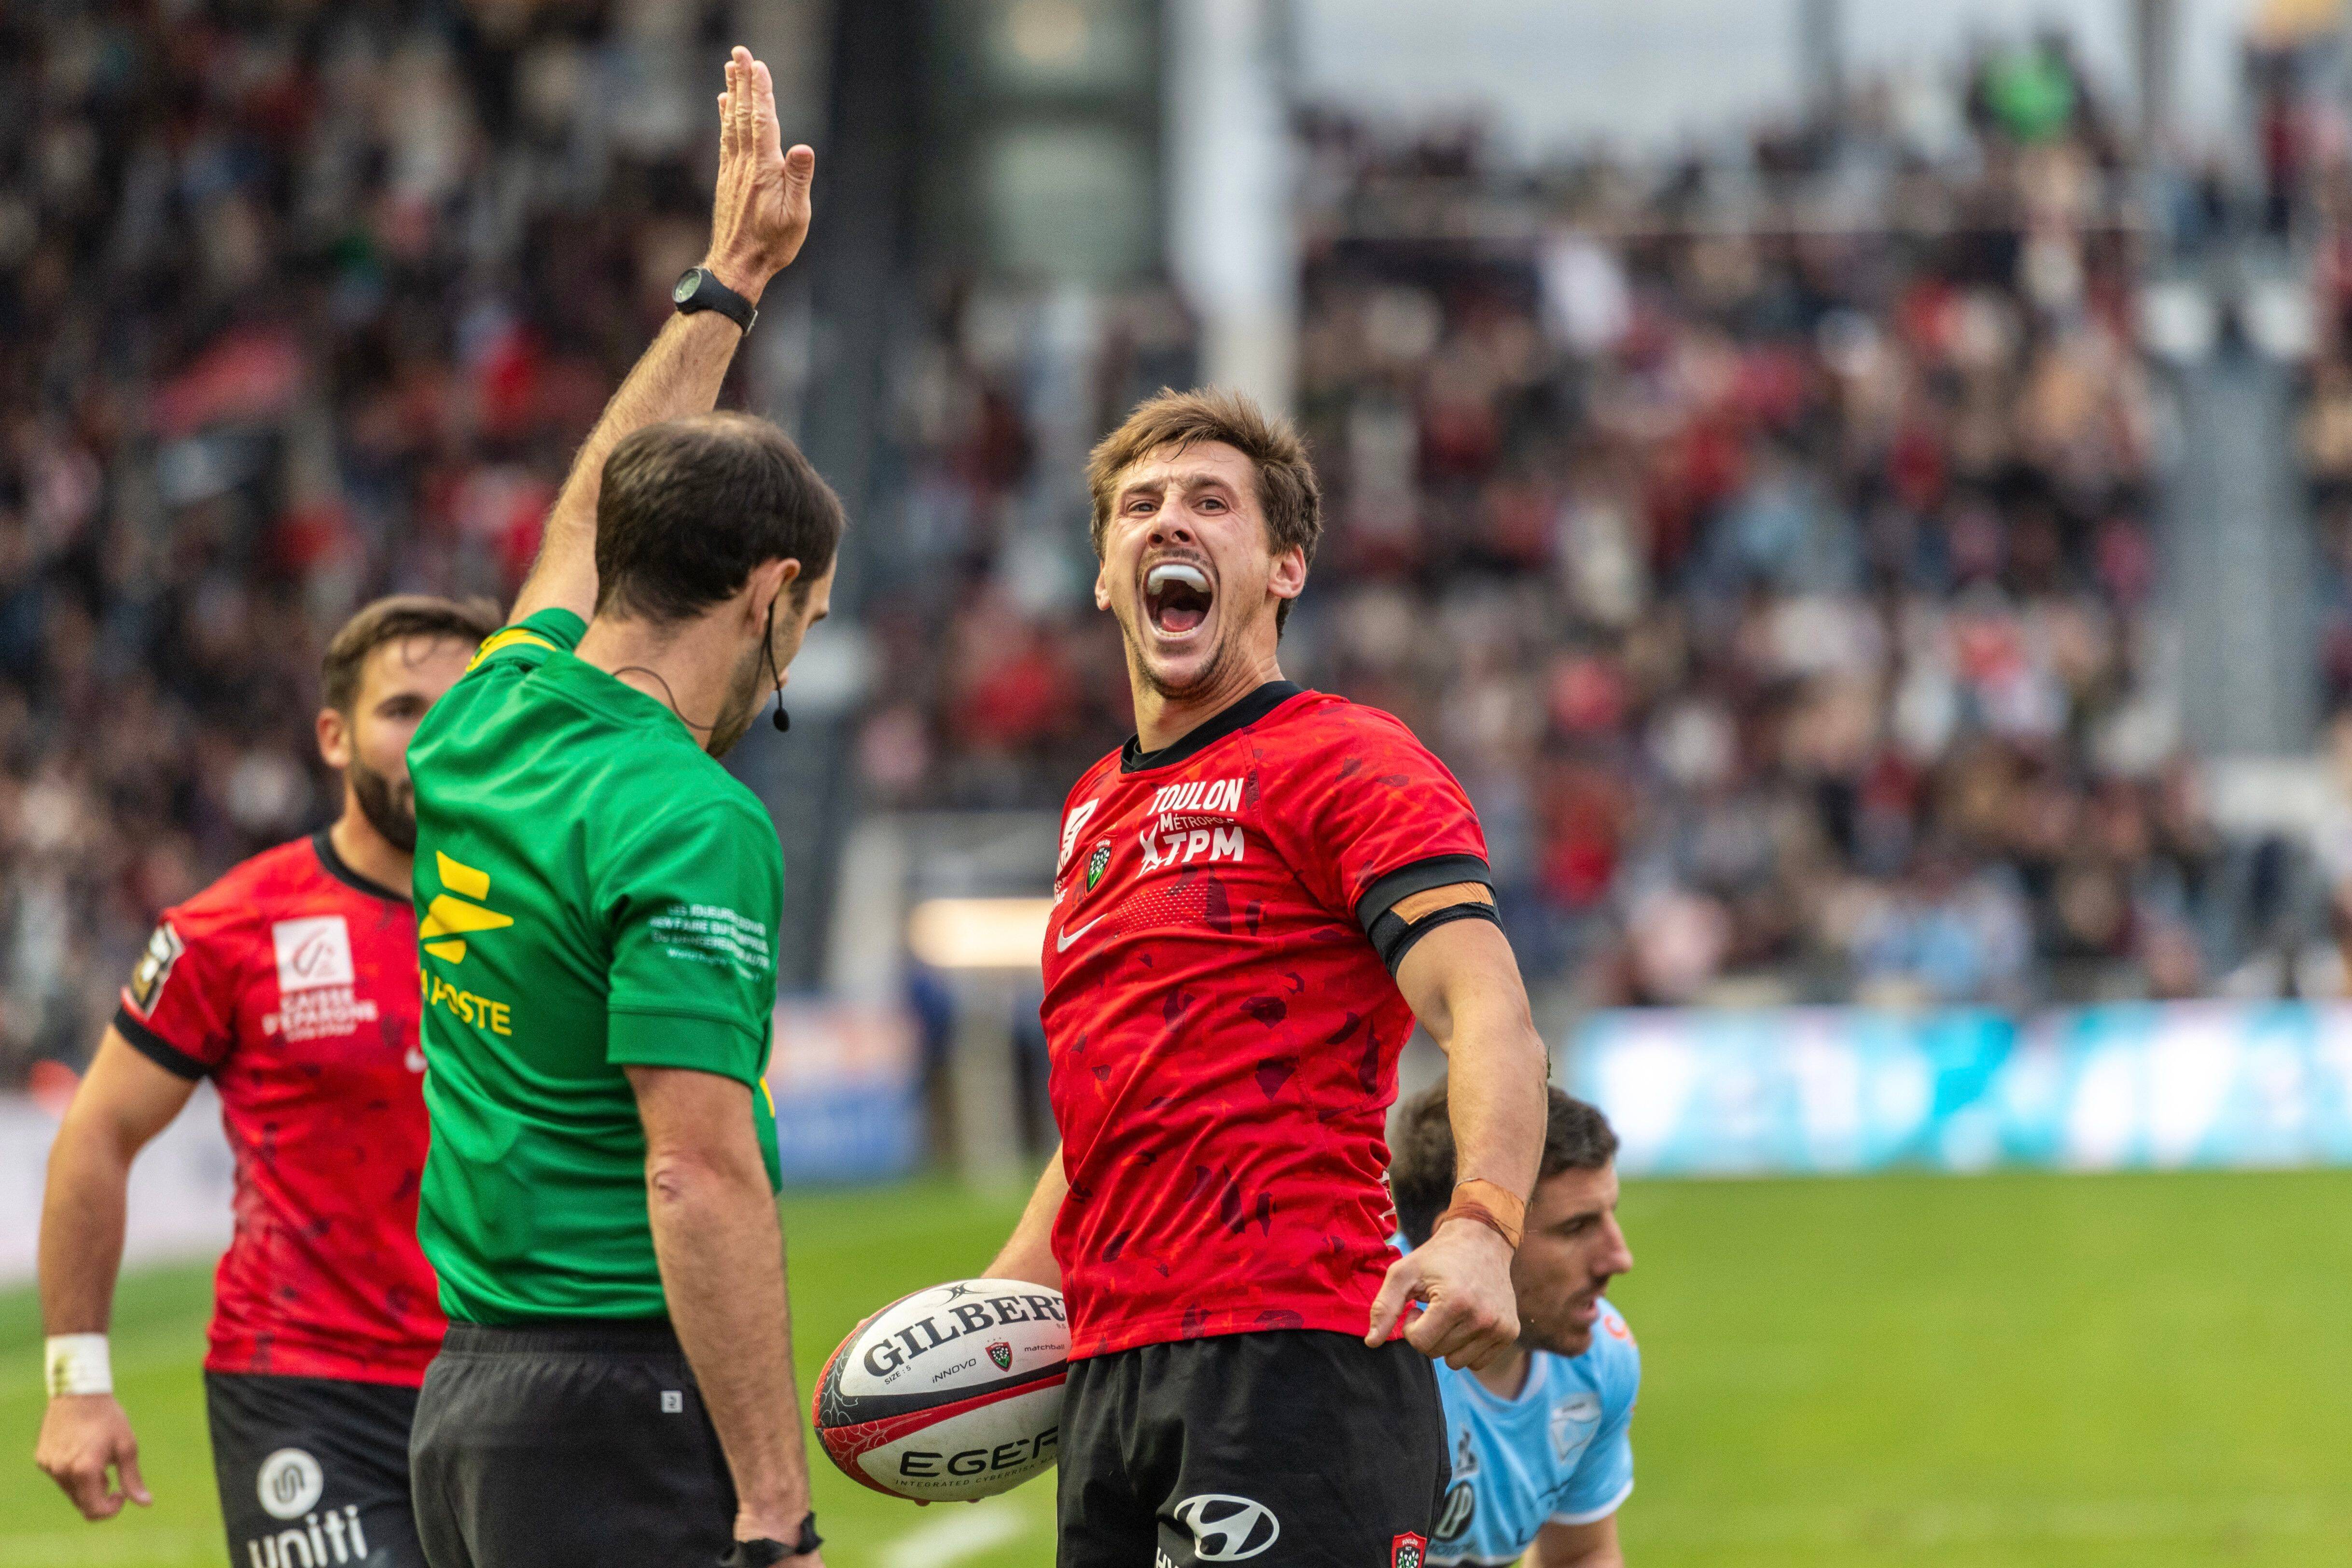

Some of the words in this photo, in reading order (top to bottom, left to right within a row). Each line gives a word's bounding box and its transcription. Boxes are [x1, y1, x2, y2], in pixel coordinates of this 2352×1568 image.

[1147, 777, 1244, 816] TOULON
[1163, 826, 1244, 866] TPM
[863, 1295, 1066, 1377] GILBER
[884, 1371, 902, 1385] SIZE
[895, 1479, 970, 1487] INTEGRATED
